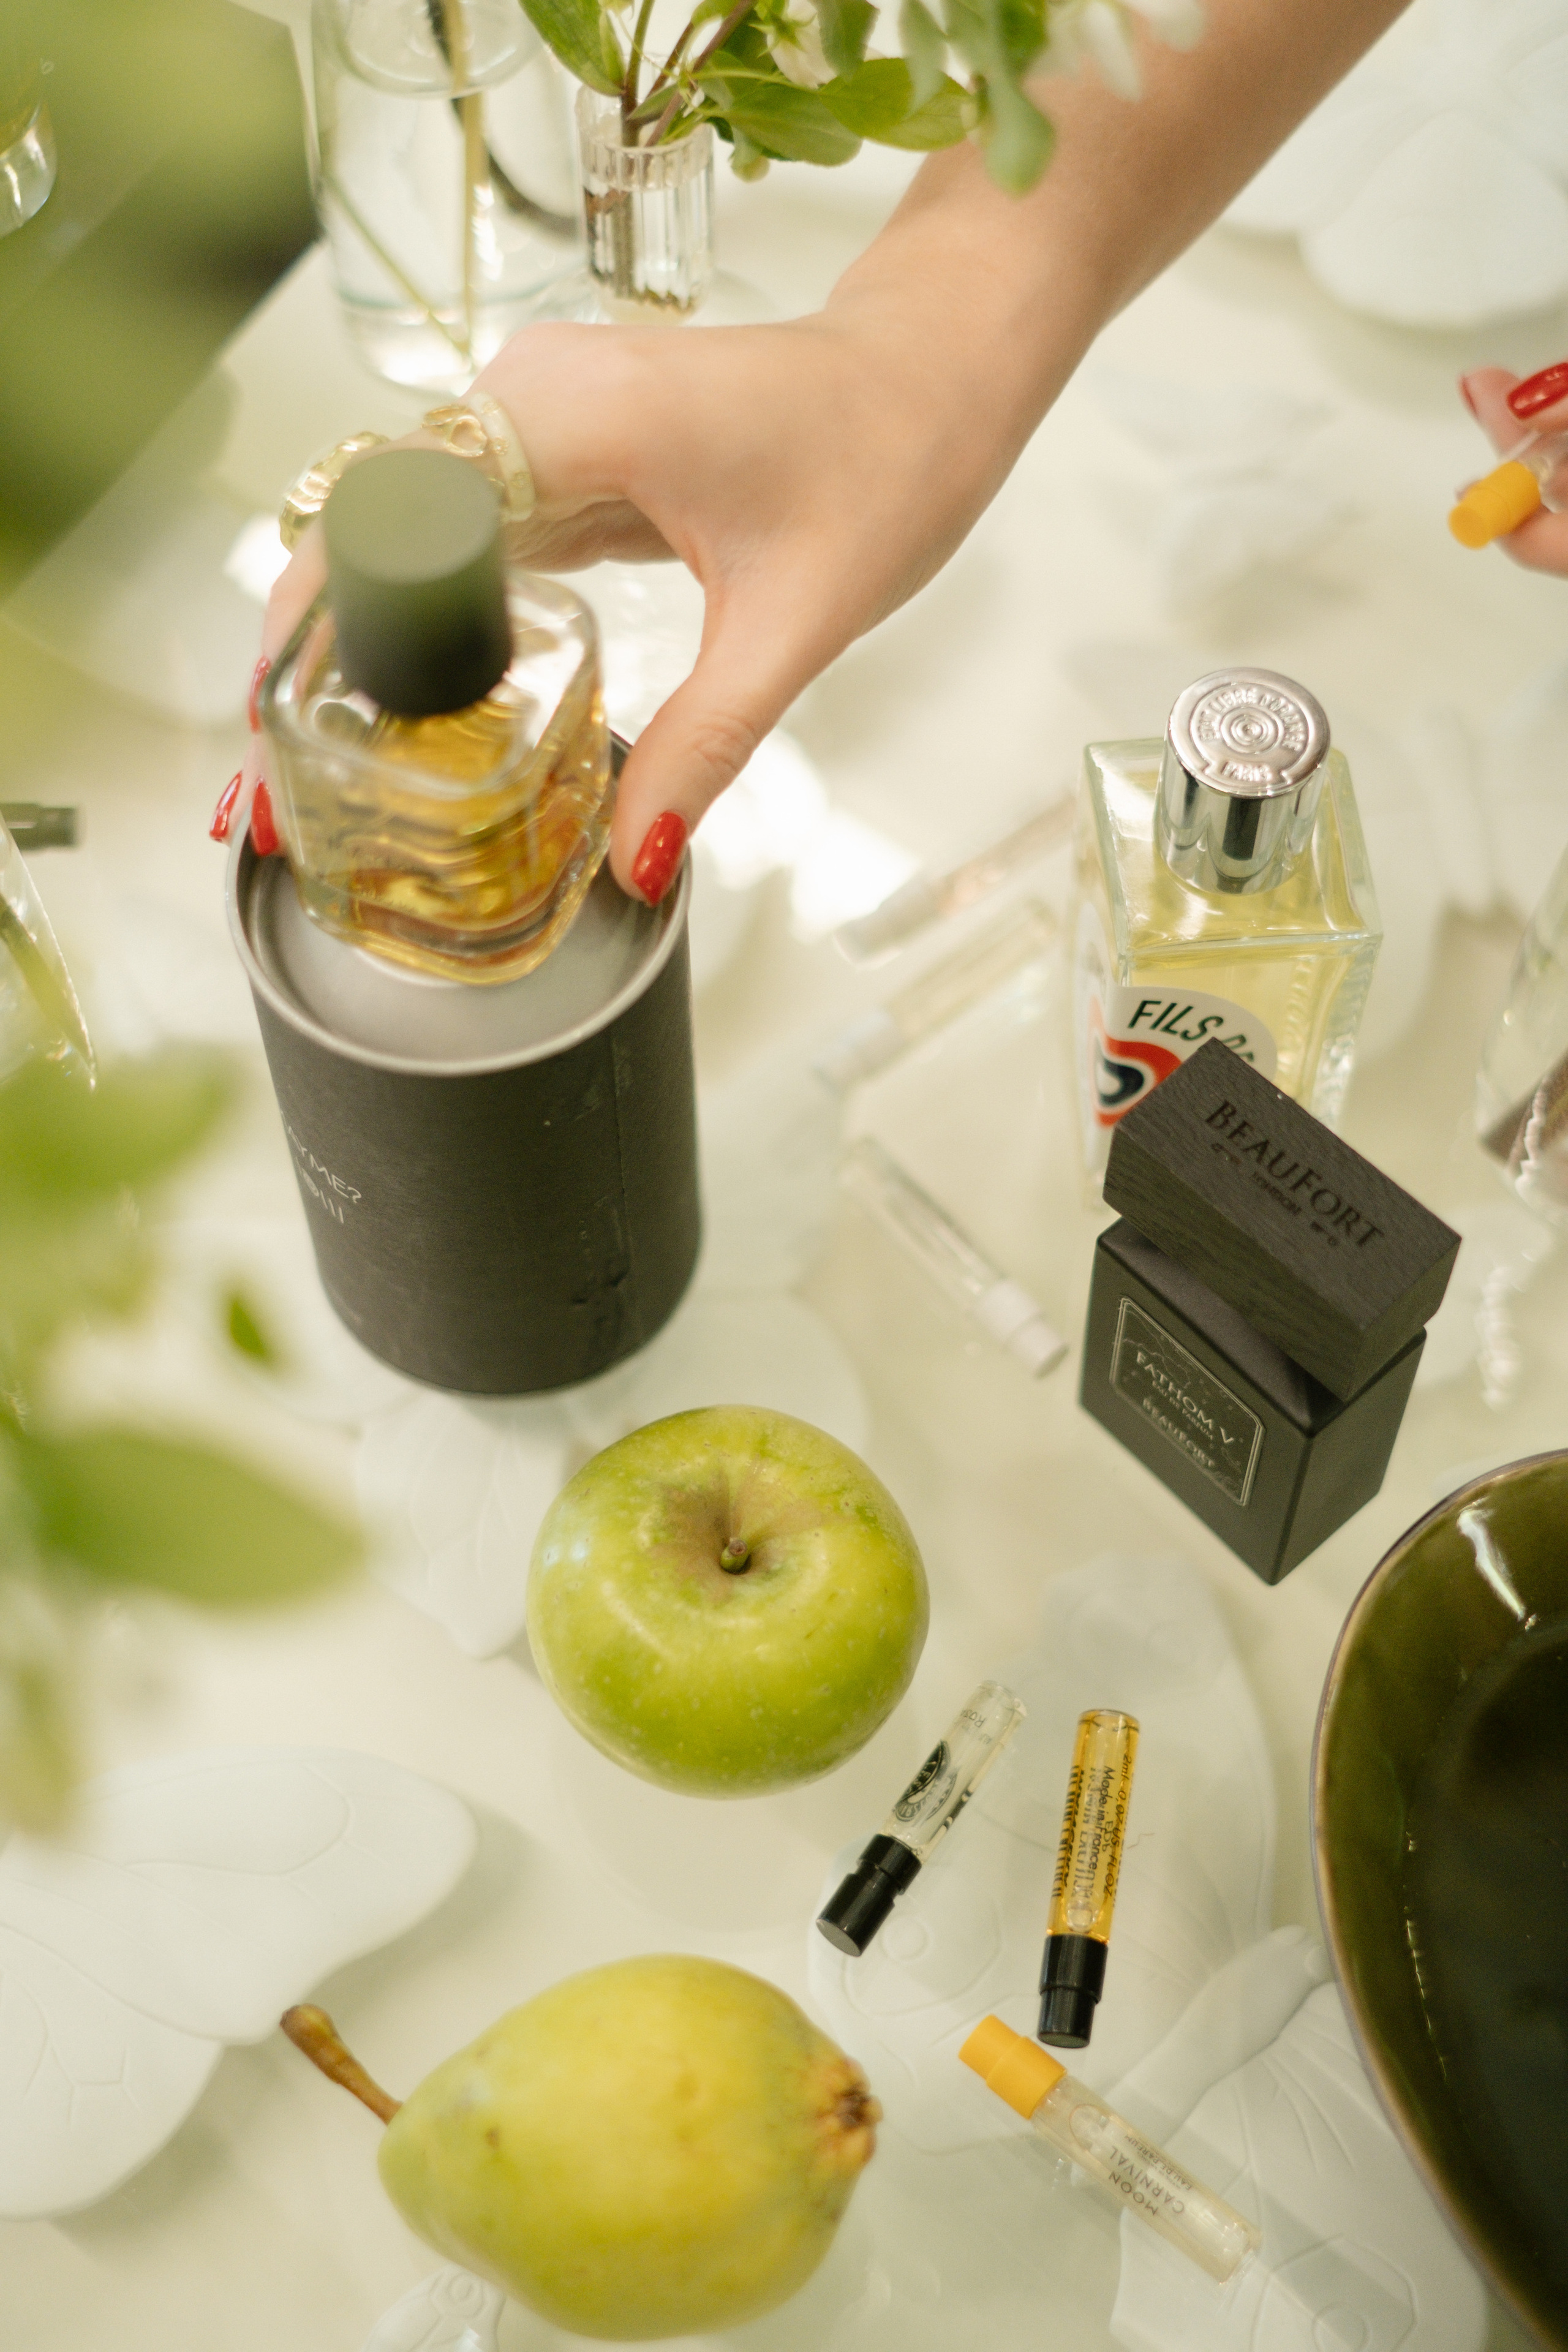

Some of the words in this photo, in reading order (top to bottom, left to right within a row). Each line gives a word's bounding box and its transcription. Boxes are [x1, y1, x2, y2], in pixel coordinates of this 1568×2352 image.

[1209, 687, 1257, 714] LIBRE
[1221, 761, 1273, 782] PARIS
[1127, 1000, 1224, 1041] FILS
[1205, 1100, 1385, 1248] BEAUFORT
[1136, 1351, 1215, 1431] FATHOM
[1219, 1426, 1234, 1444] V
[1142, 1397, 1215, 1468] BEAUFORT
[1098, 1765, 1116, 1805] Made
[1096, 1809, 1109, 1822] in
[1088, 1825, 1107, 1870] France
[1124, 2135, 1160, 2164] PARFUM
[1161, 2163, 1173, 2175] DE
[1108, 2171, 1159, 2215] MOON
[1109, 2146, 1185, 2214] CARNIVAL
[1174, 2174, 1193, 2190] EAU
